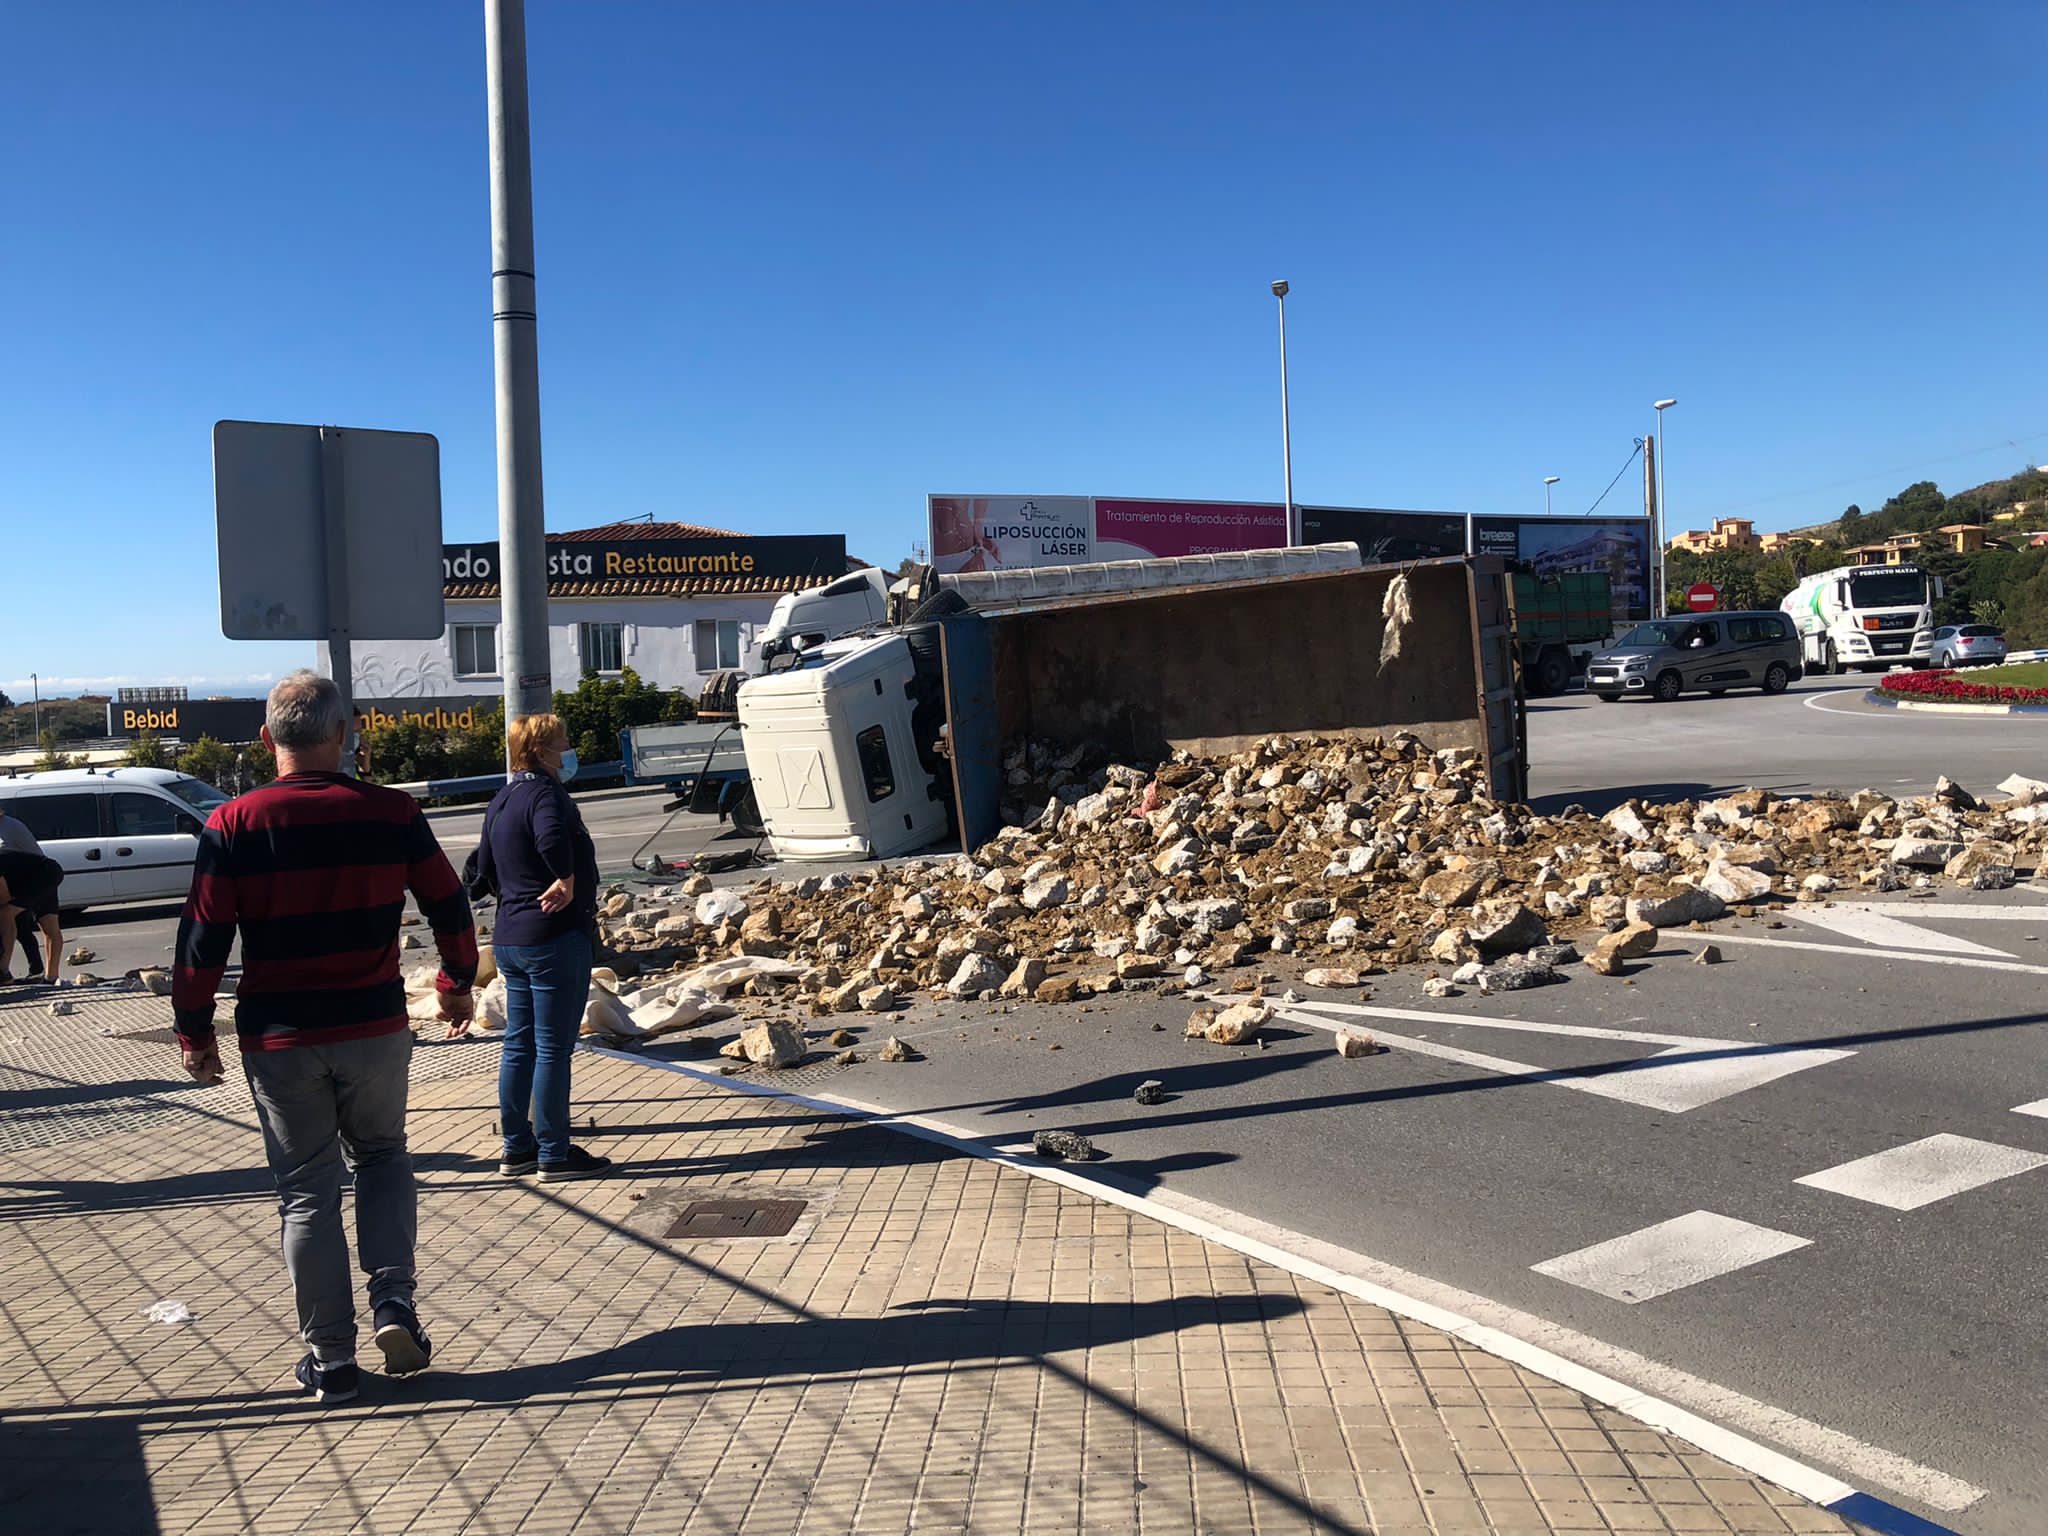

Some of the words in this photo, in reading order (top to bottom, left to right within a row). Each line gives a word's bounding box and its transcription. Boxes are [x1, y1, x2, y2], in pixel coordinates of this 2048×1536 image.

[1105, 510, 1167, 523] Tratamiento
[1169, 512, 1183, 523] de
[1184, 512, 1250, 525] Reproducción
[1252, 515, 1286, 526] Asistida
[983, 523, 1086, 539] LIPOSUCCIÓN
[1041, 539, 1086, 555] LÁSER
[605, 552, 754, 574] Restaurante
[123, 707, 178, 729] Bebid
